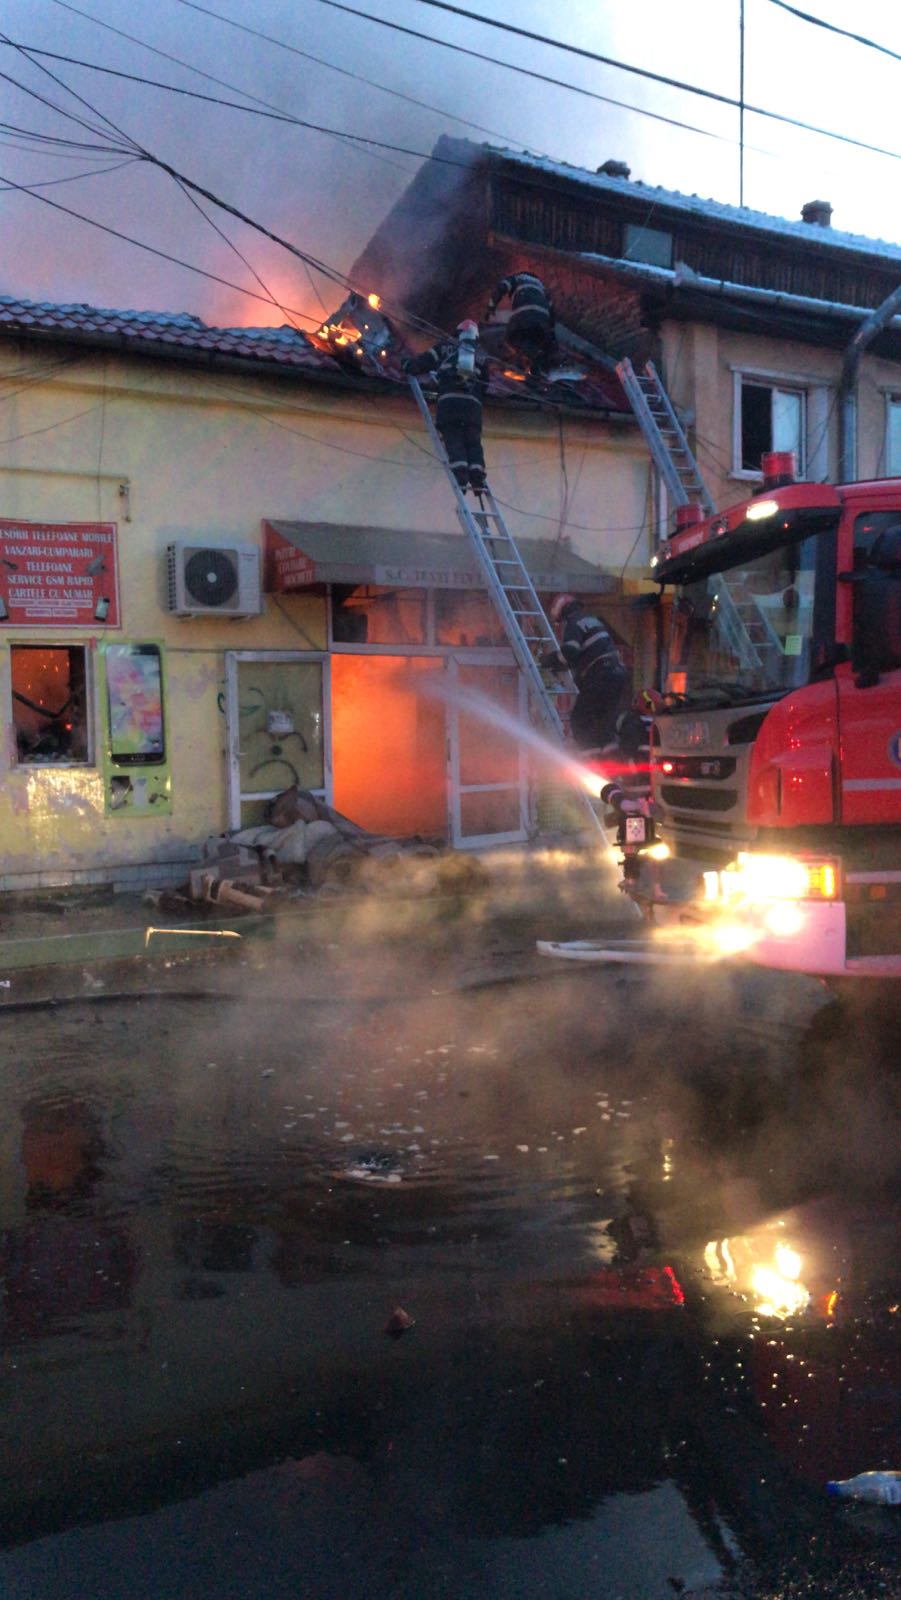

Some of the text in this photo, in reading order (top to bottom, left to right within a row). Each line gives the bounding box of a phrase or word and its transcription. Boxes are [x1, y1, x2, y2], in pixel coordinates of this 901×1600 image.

[33, 531, 78, 541] TELEFOANE
[82, 533, 113, 543] MOBILE
[27, 561, 72, 572] TELEFOANE
[8, 575, 94, 586] SERVICE GSM RAPID
[9, 589, 93, 599] CARTELE CU NUMAR
